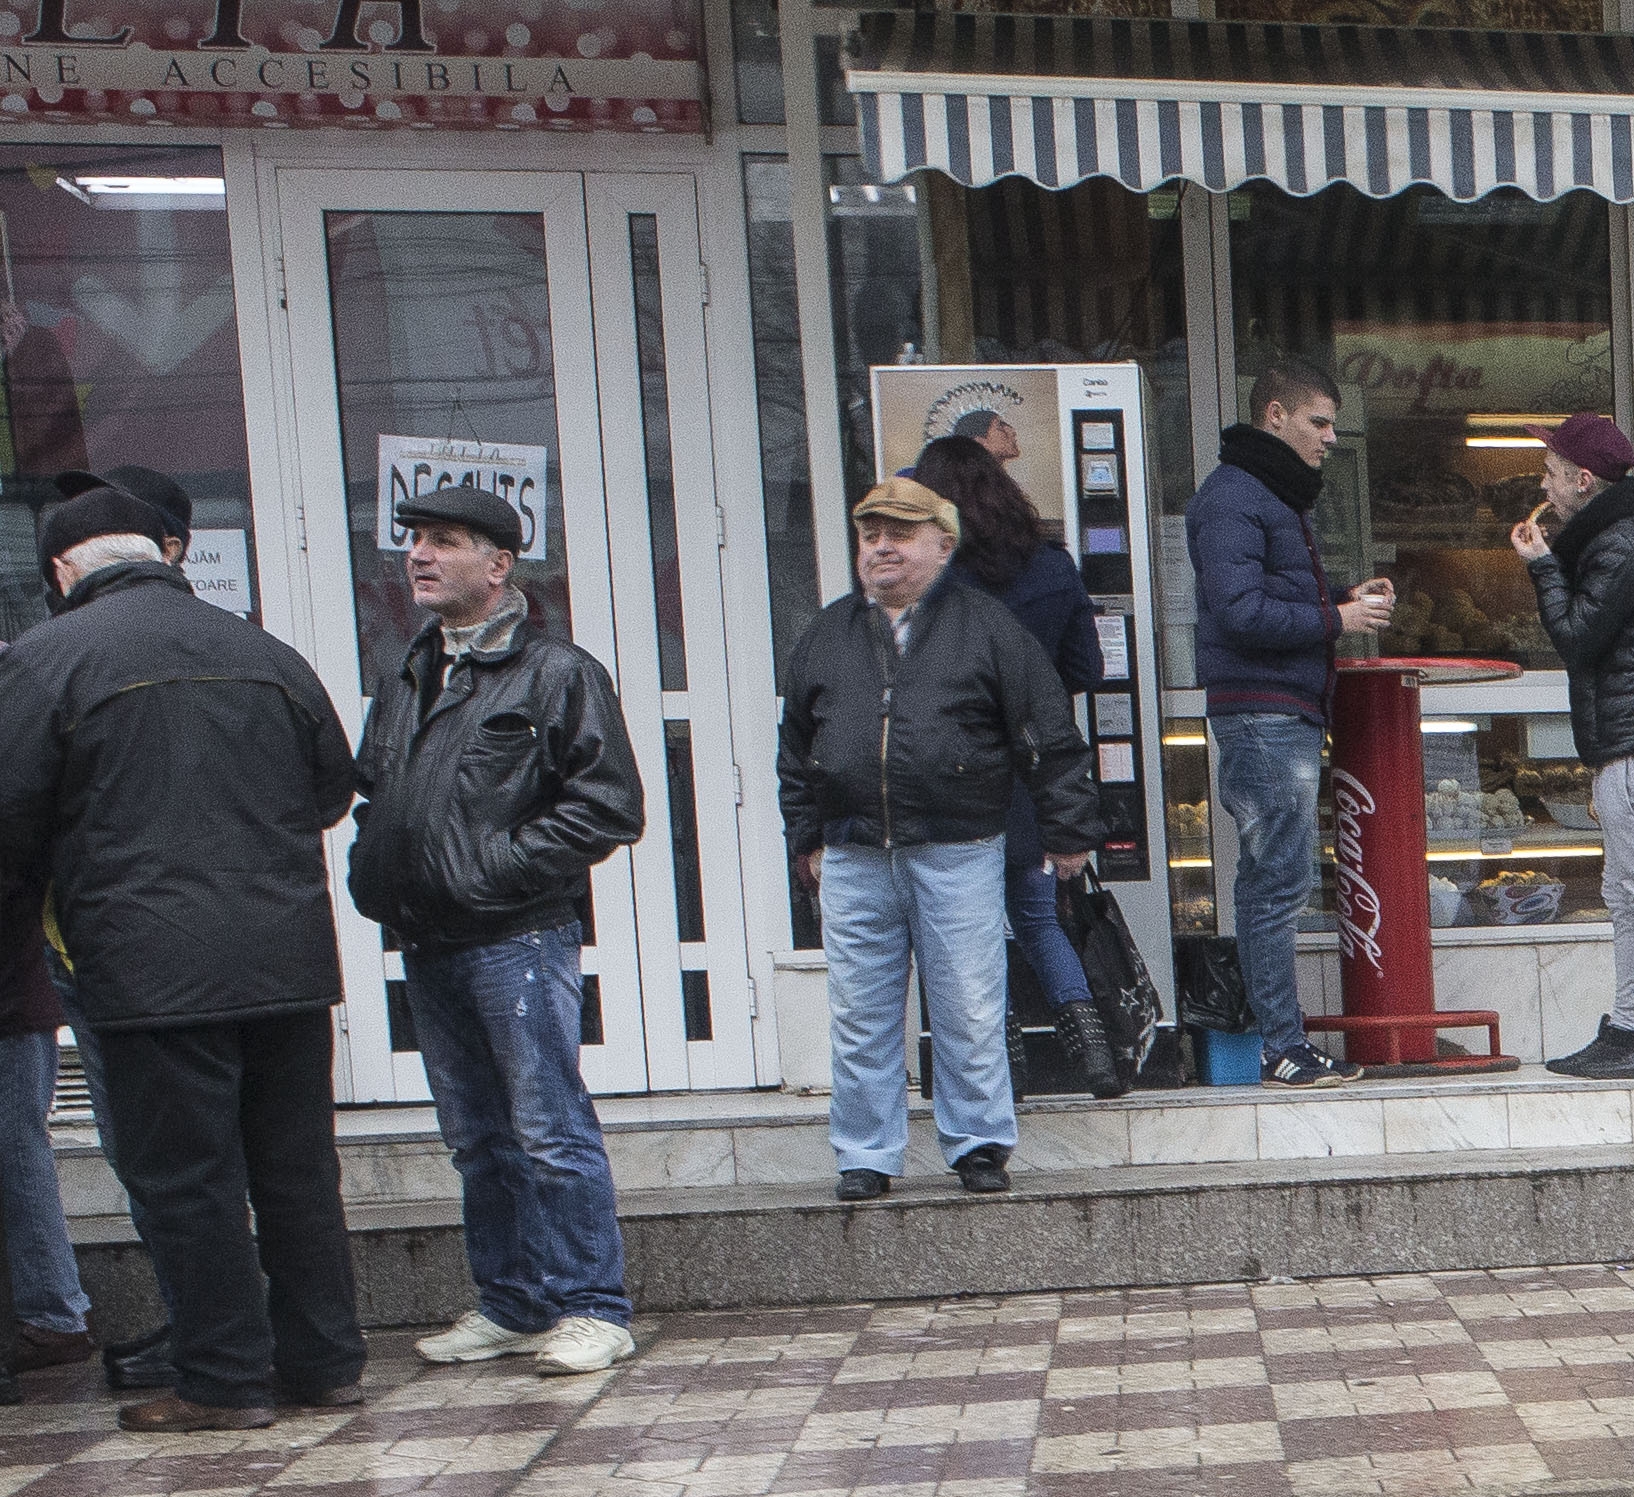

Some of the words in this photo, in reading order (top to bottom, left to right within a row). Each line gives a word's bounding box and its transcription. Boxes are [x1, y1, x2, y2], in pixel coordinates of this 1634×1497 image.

[3, 53, 81, 85] NE
[162, 57, 577, 95] ACCESIBILA
[1333, 767, 1382, 971] Coca-Cola
